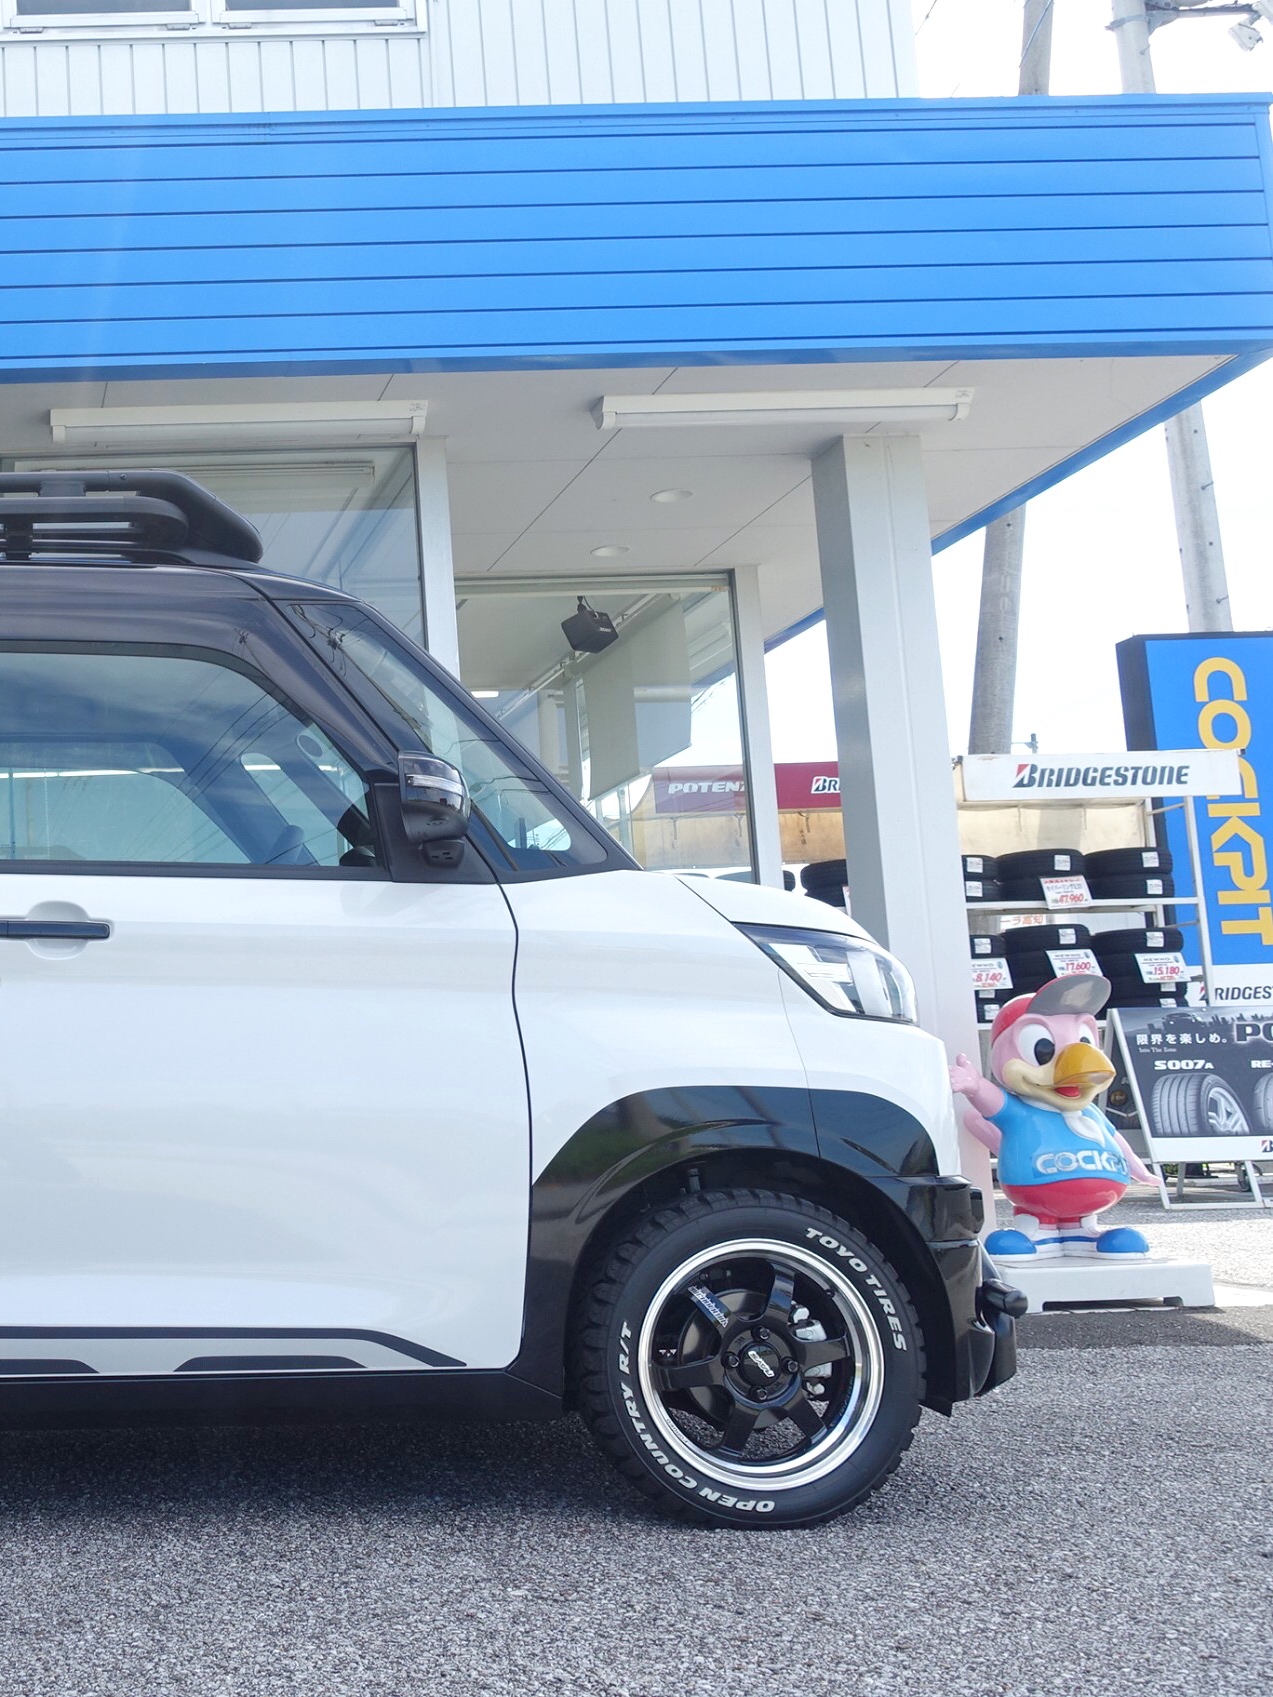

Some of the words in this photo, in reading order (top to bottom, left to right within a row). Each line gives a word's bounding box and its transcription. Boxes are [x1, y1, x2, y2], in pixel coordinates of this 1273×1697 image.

[1011, 762, 1191, 788] BRIDGESTONE
[1136, 1033, 1227, 1046] 限界を楽しめ。
[805, 1227, 869, 1272] TOYO
[866, 1273, 907, 1351] TIRES
[617, 1321, 632, 1376] R/T
[620, 1381, 699, 1489] COUNTRY
[698, 1486, 776, 1513] OPEN
